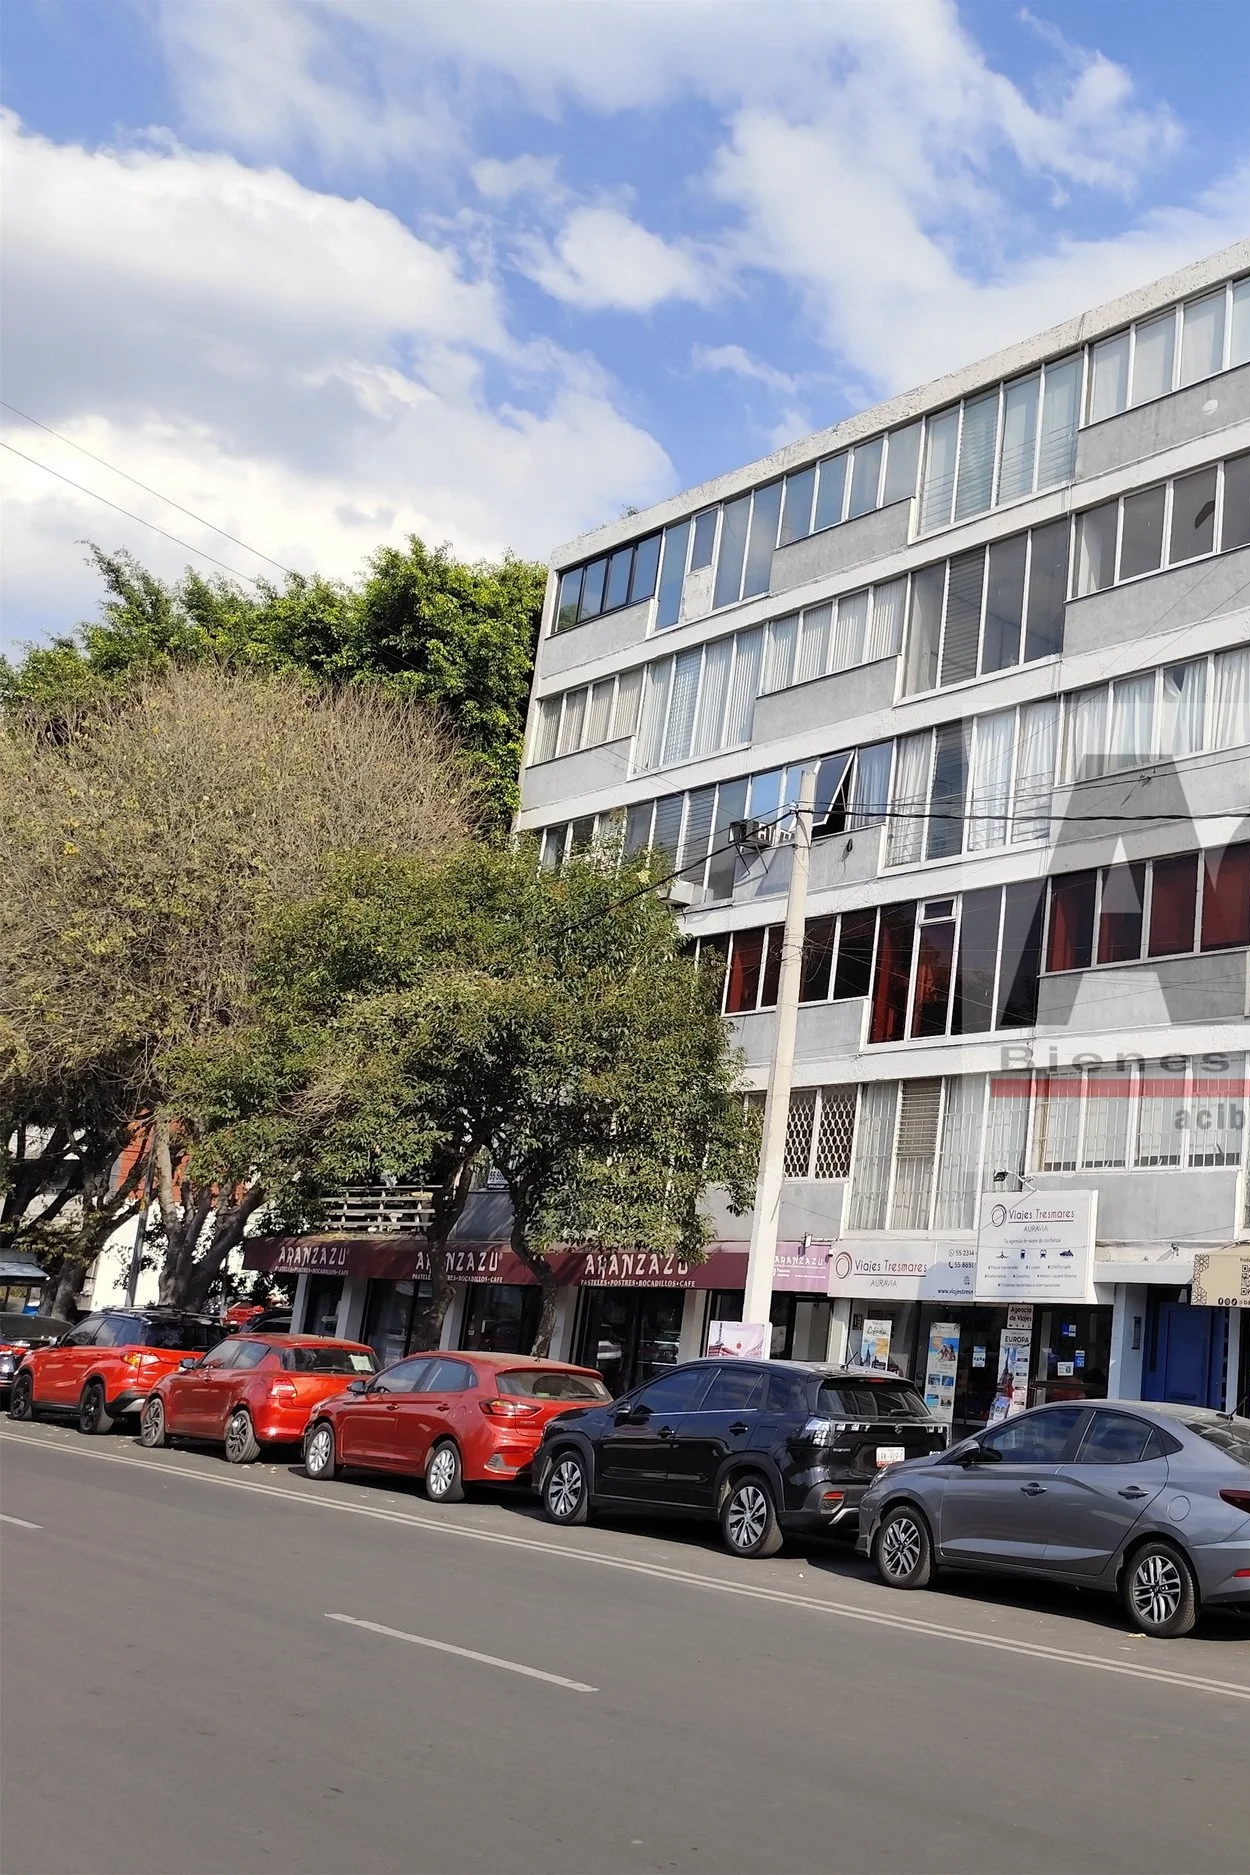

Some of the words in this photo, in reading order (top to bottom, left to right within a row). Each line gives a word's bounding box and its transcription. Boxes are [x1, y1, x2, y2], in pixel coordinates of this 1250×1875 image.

[1009, 1210, 1033, 1220] Viajes
[1036, 1209, 1075, 1218] Tresmares
[279, 1246, 346, 1266] ARANZAZU
[416, 1251, 498, 1272] ANZAZU
[855, 1260, 881, 1272] Viajes
[884, 1260, 927, 1272] Tresmares
